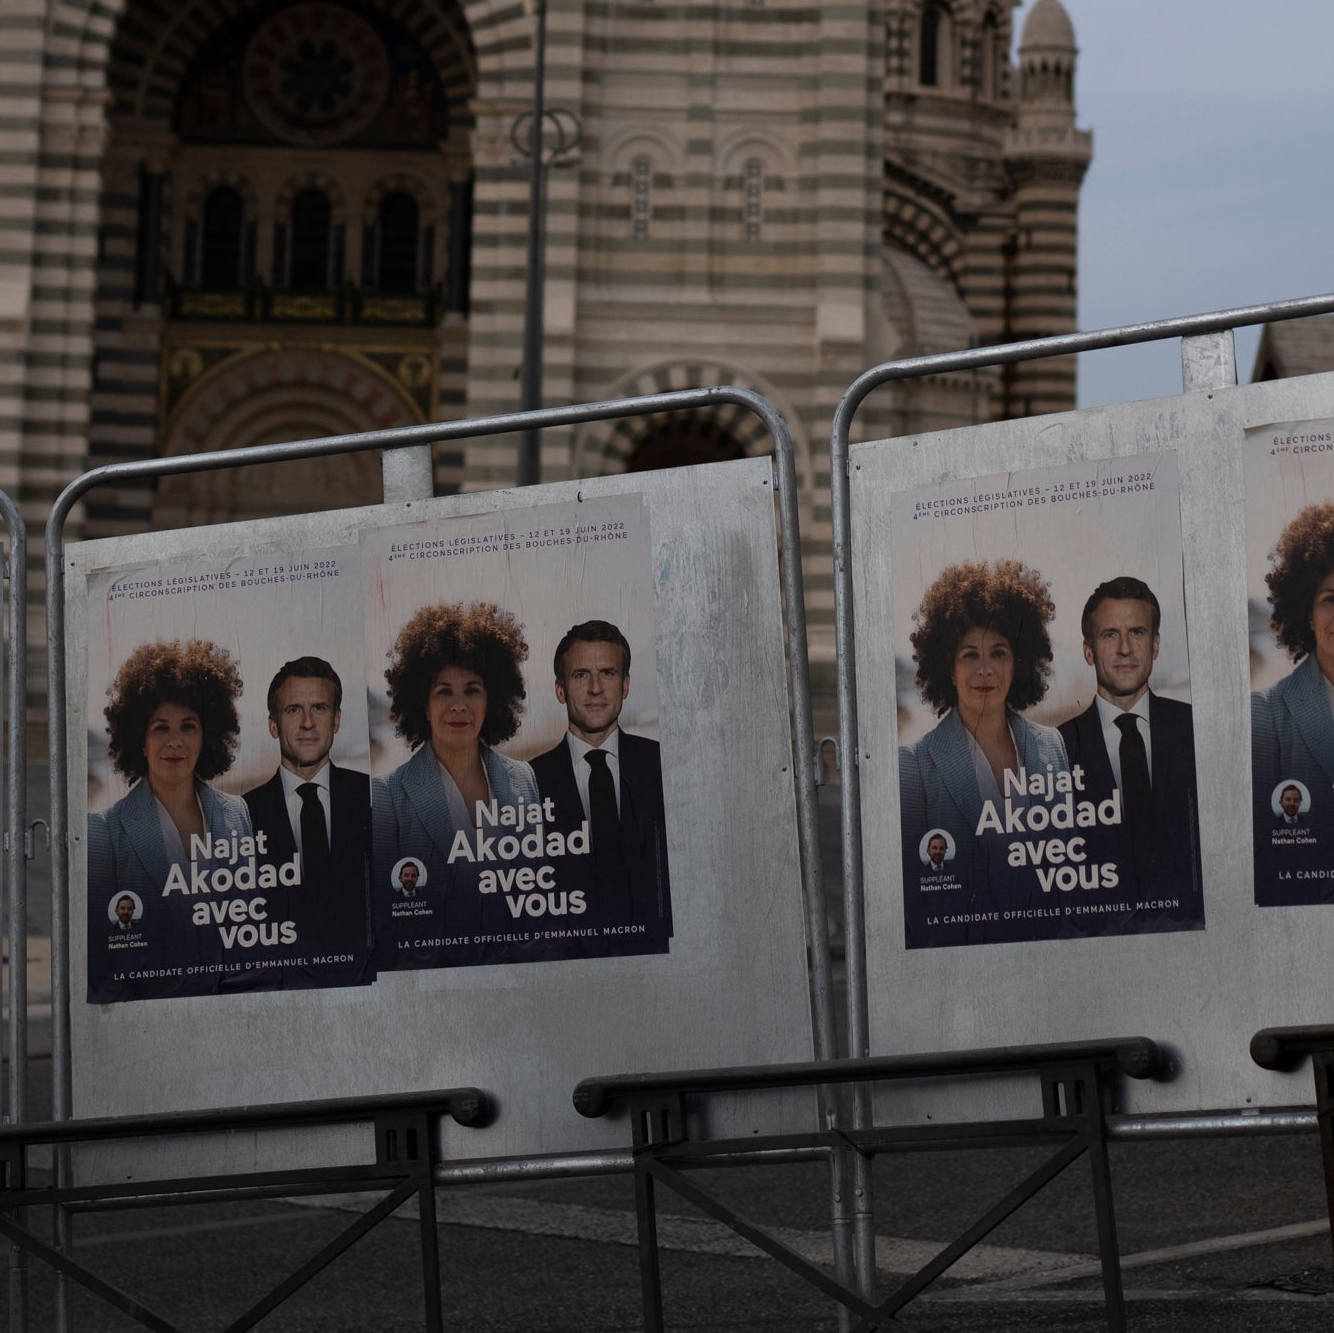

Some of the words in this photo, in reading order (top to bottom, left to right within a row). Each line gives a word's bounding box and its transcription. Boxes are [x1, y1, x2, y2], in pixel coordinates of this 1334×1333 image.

[1273, 433, 1331, 445] ÉLECTIONS
[915, 496, 968, 510] ÉLECTIONS
[973, 487, 1040, 503] LÉGISLATIVES
[1054, 484, 1064, 492] 12
[1069, 482, 1080, 490] ET
[1085, 480, 1096, 488] 19
[1101, 476, 1123, 486] JUIN
[1128, 472, 1152, 482] 2022
[933, 499, 1023, 518] CIRCONSCRIPTION
[1028, 496, 1046, 506] DES
[1050, 482, 1155, 503] BOUCHES-DU-RHÔNE
[391, 540, 444, 552] ÉLECTIONS
[449, 533, 515, 546] LÉGISLATIVES
[559, 527, 570, 535] 19
[575, 525, 597, 534] JUIN
[601, 522, 624, 531] 2022
[409, 544, 498, 559] CIRCONSCRIPTION
[503, 542, 521, 550] DES
[525, 531, 627, 548] BOUCHES-DU-RHÔNE
[111, 580, 162, 592] ÉLECTIONS
[167, 572, 231, 586] LÉGISLATIVES
[244, 569, 254, 577] 12
[289, 563, 310, 572] JUIN
[314, 560, 337, 569] 2022
[129, 583, 214, 599] CIRCONSCRIPTION
[219, 581, 236, 589] DES
[240, 569, 339, 587] BOUCHES-DU-RHÔNE
[1003, 764, 1085, 802] Najat
[475, 796, 555, 832] Najat
[975, 789, 1121, 835] Akodad
[190, 830, 267, 865] Najat
[447, 820, 589, 864] Akodad
[1007, 836, 1086, 867] avec
[162, 852, 300, 896] Akodad
[478, 865, 556, 894] avec
[920, 883, 941, 892] Nathan
[943, 882, 961, 890] Cohen
[1035, 862, 1119, 892] vous
[1278, 871, 1291, 879] LA
[192, 896, 267, 926] avec
[392, 909, 412, 917] Nathan
[505, 890, 587, 918] vous
[927, 917, 939, 925] LA
[943, 912, 999, 924] CANDIDATE
[1003, 908, 1060, 919] OFFICIELLE
[1065, 902, 1132, 915] D'EMMANUEL
[1136, 899, 1180, 909] MACRON
[218, 920, 297, 949] vous
[398, 941, 410, 949] LA
[414, 937, 469, 947] CANDIDATE
[473, 932, 529, 943] OFFICIELLE
[534, 927, 599, 939] D'EMMANUEL
[603, 925, 645, 934] MACRON
[114, 972, 125, 980] LA
[129, 968, 183, 979] CANDIDATE
[187, 963, 241, 974] OFFICIELLE
[246, 957, 308, 970] D'EMMANUEL
[312, 954, 353, 964] MACRON
